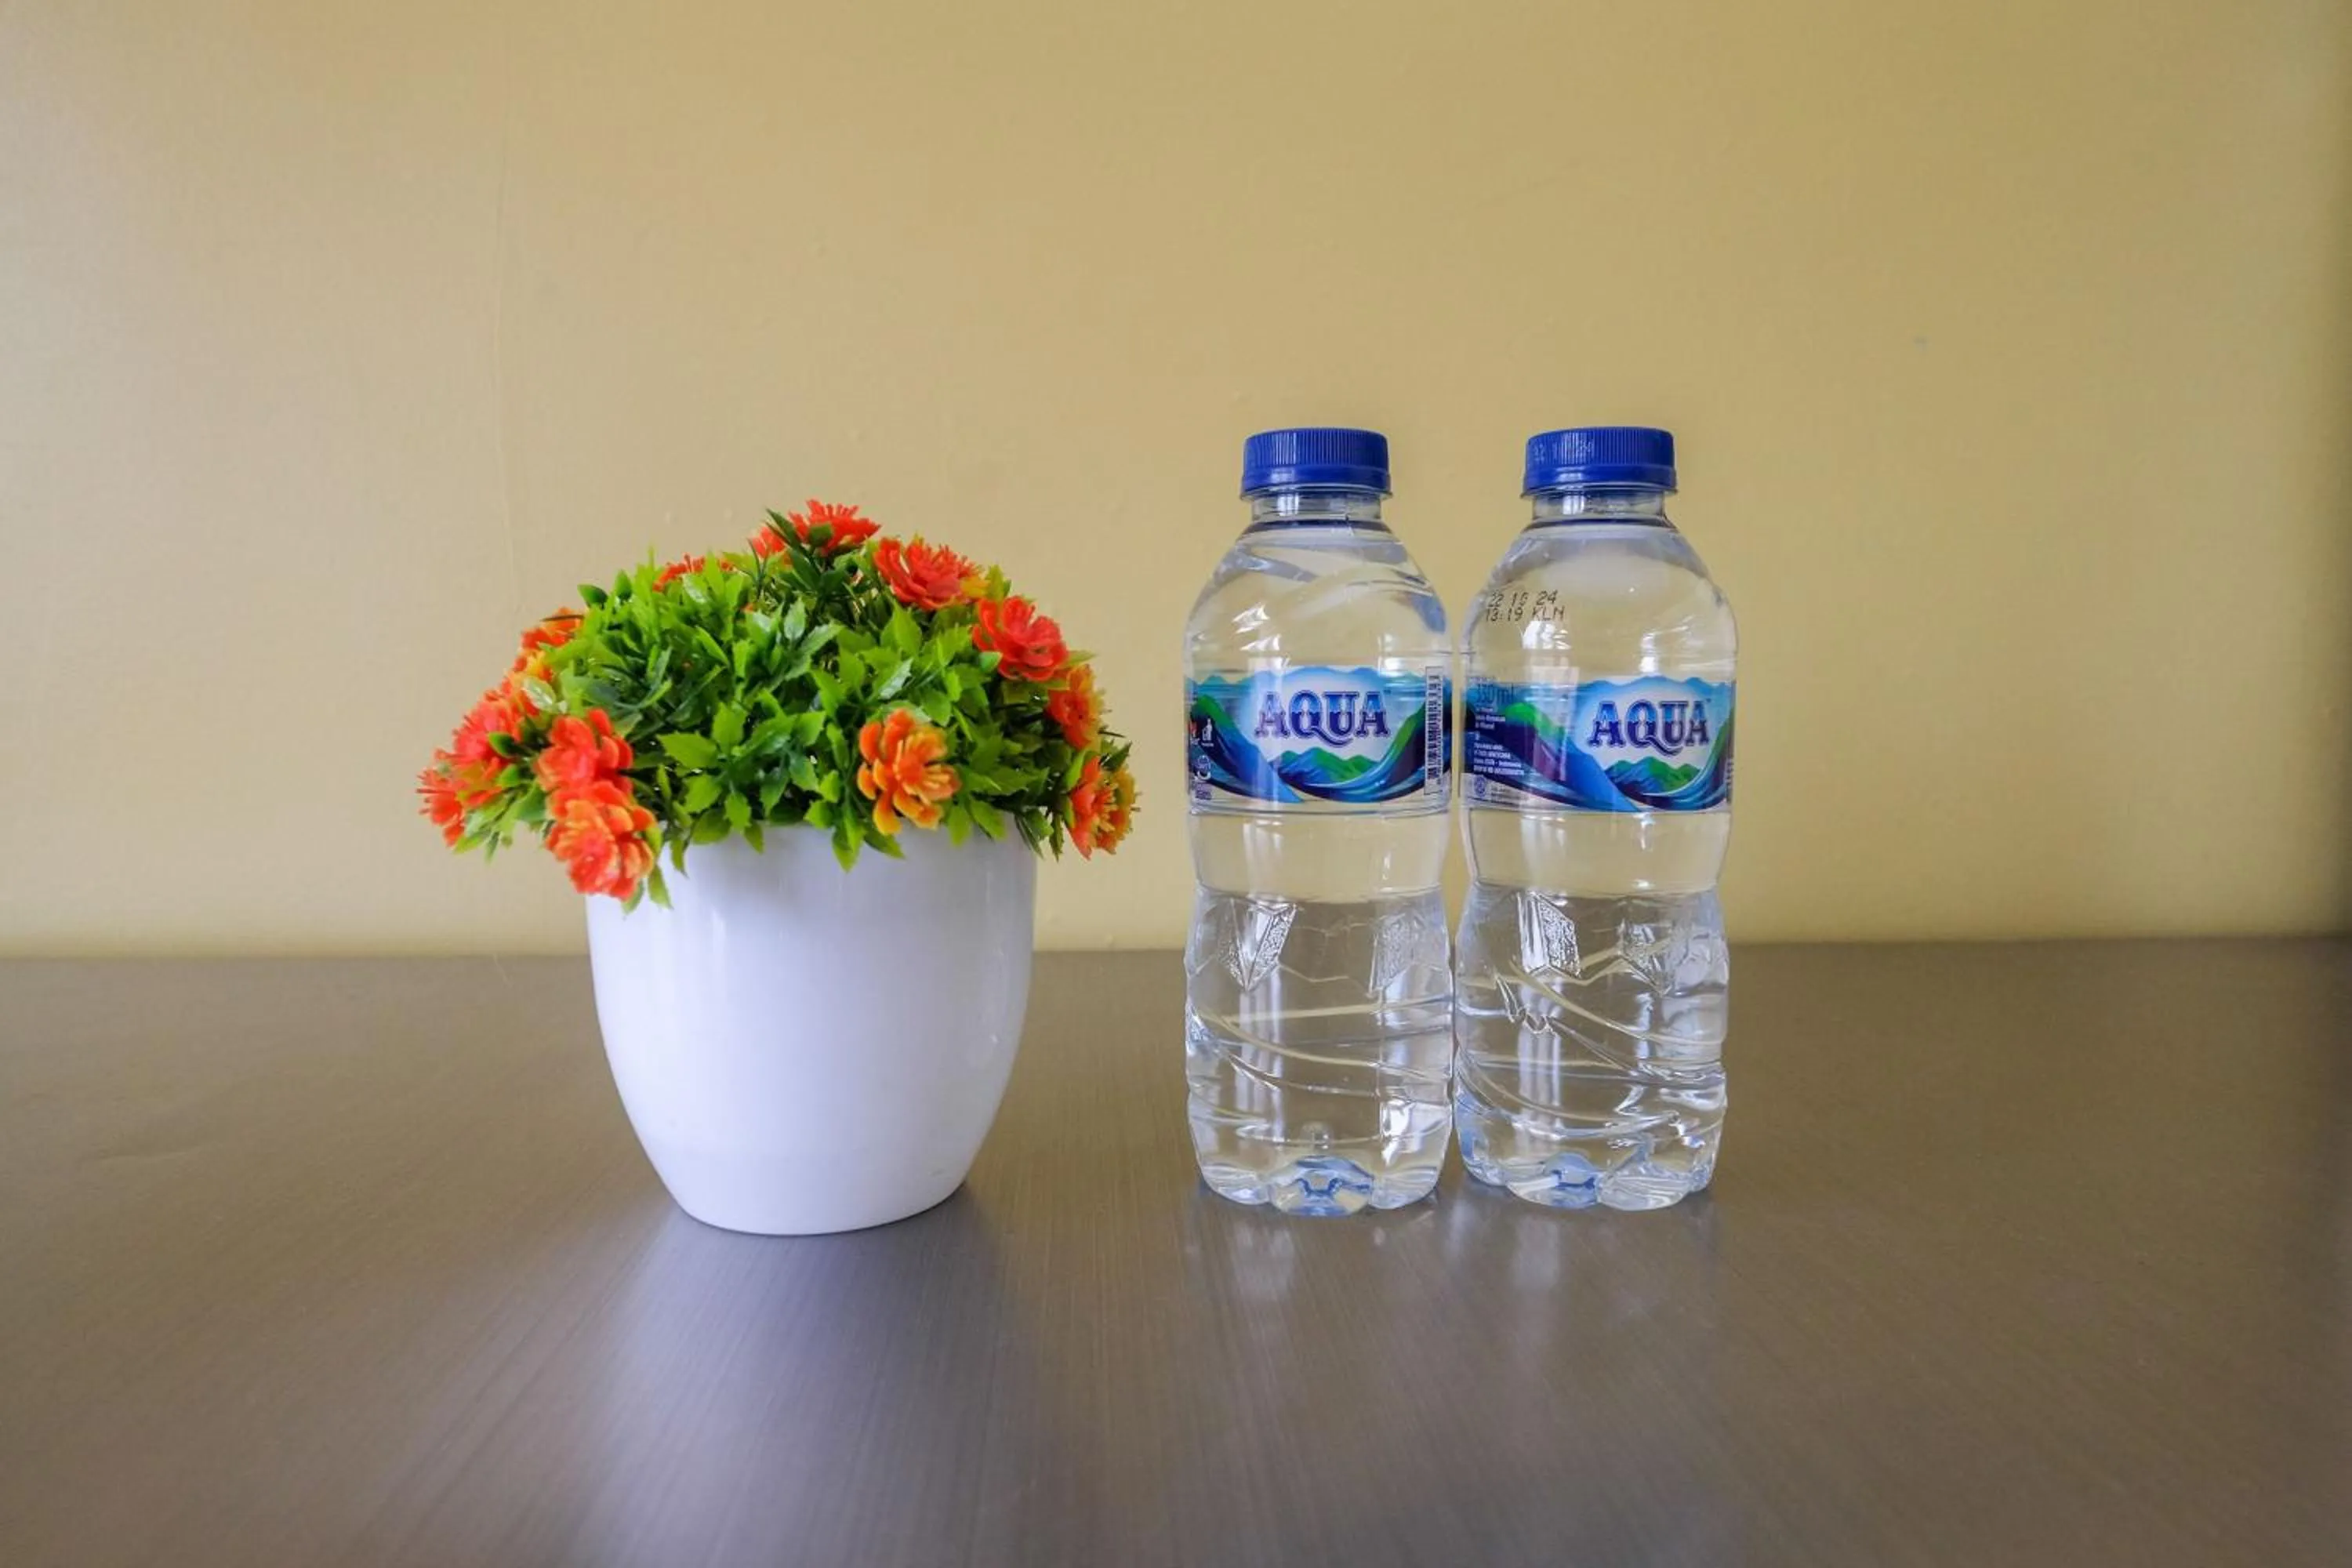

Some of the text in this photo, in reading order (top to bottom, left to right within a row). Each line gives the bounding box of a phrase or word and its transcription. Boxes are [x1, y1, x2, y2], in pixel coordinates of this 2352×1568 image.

[1536, 590, 1558, 605] 24
[1255, 690, 1391, 747] AQUA
[1588, 699, 1709, 757] AQUA
